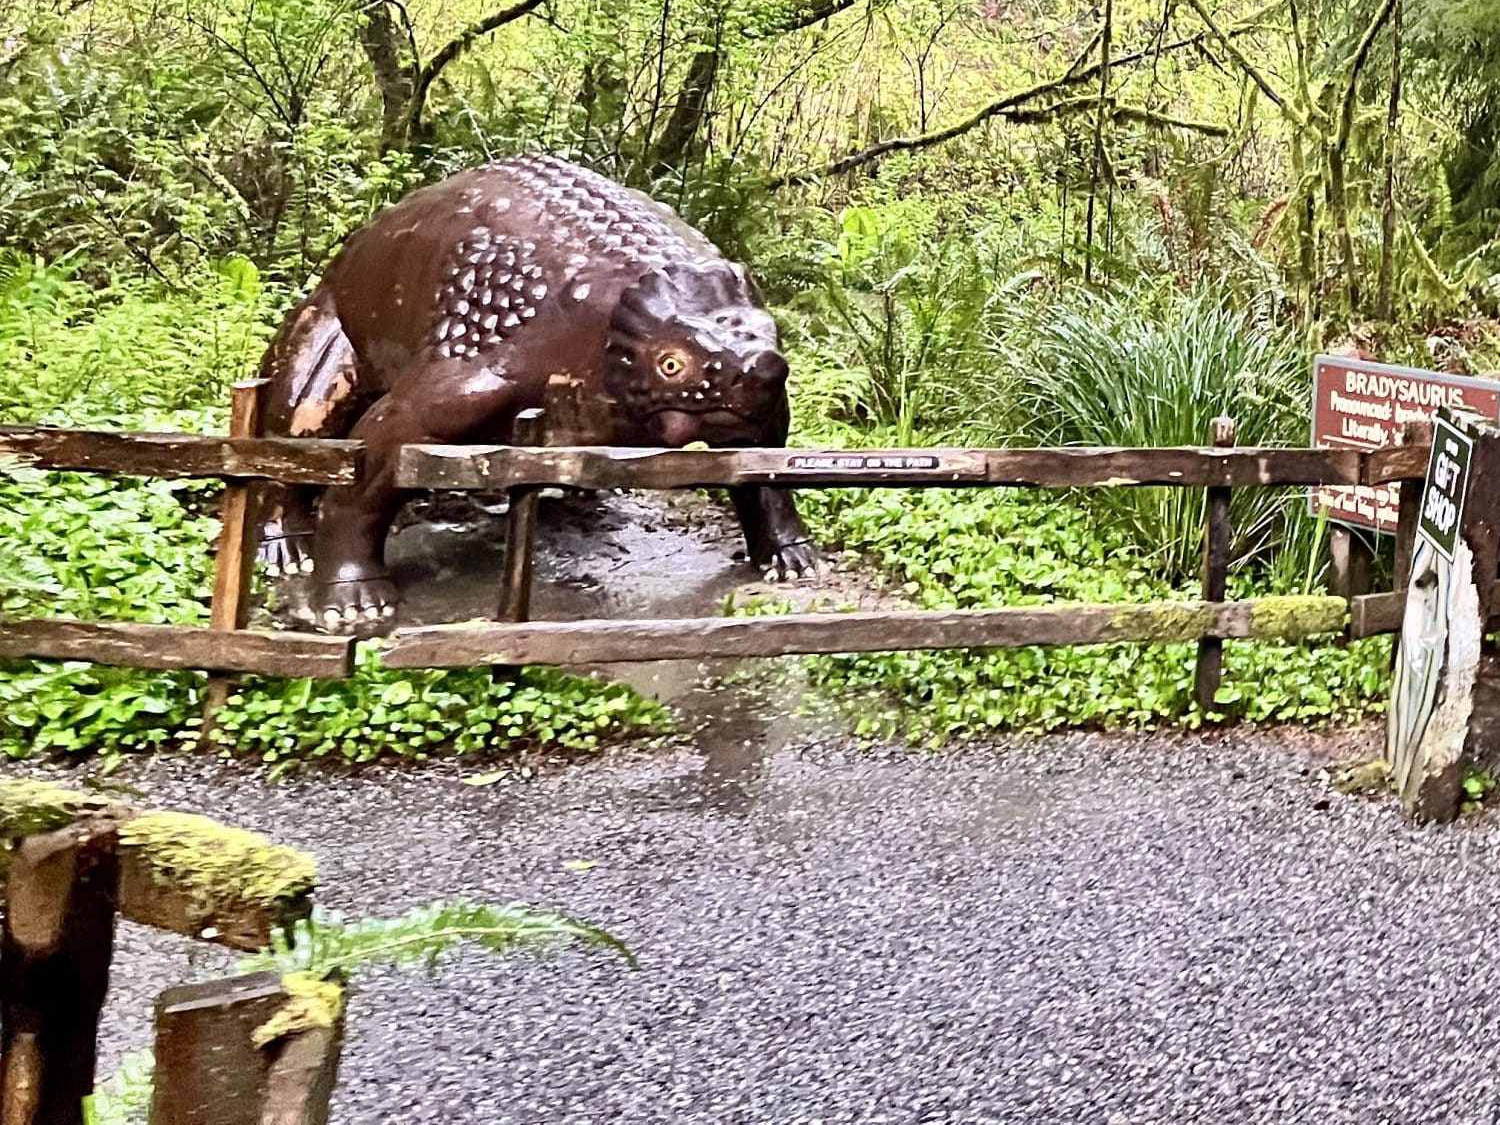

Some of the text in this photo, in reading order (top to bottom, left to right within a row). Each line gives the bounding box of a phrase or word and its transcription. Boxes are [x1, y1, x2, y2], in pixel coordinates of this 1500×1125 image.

[1345, 371, 1464, 406] BRADYSAURUS
[794, 457, 834, 468] PLEASE
[837, 457, 863, 468] STAY
[906, 458, 932, 468] PATH
[1425, 486, 1456, 535] SHOP
